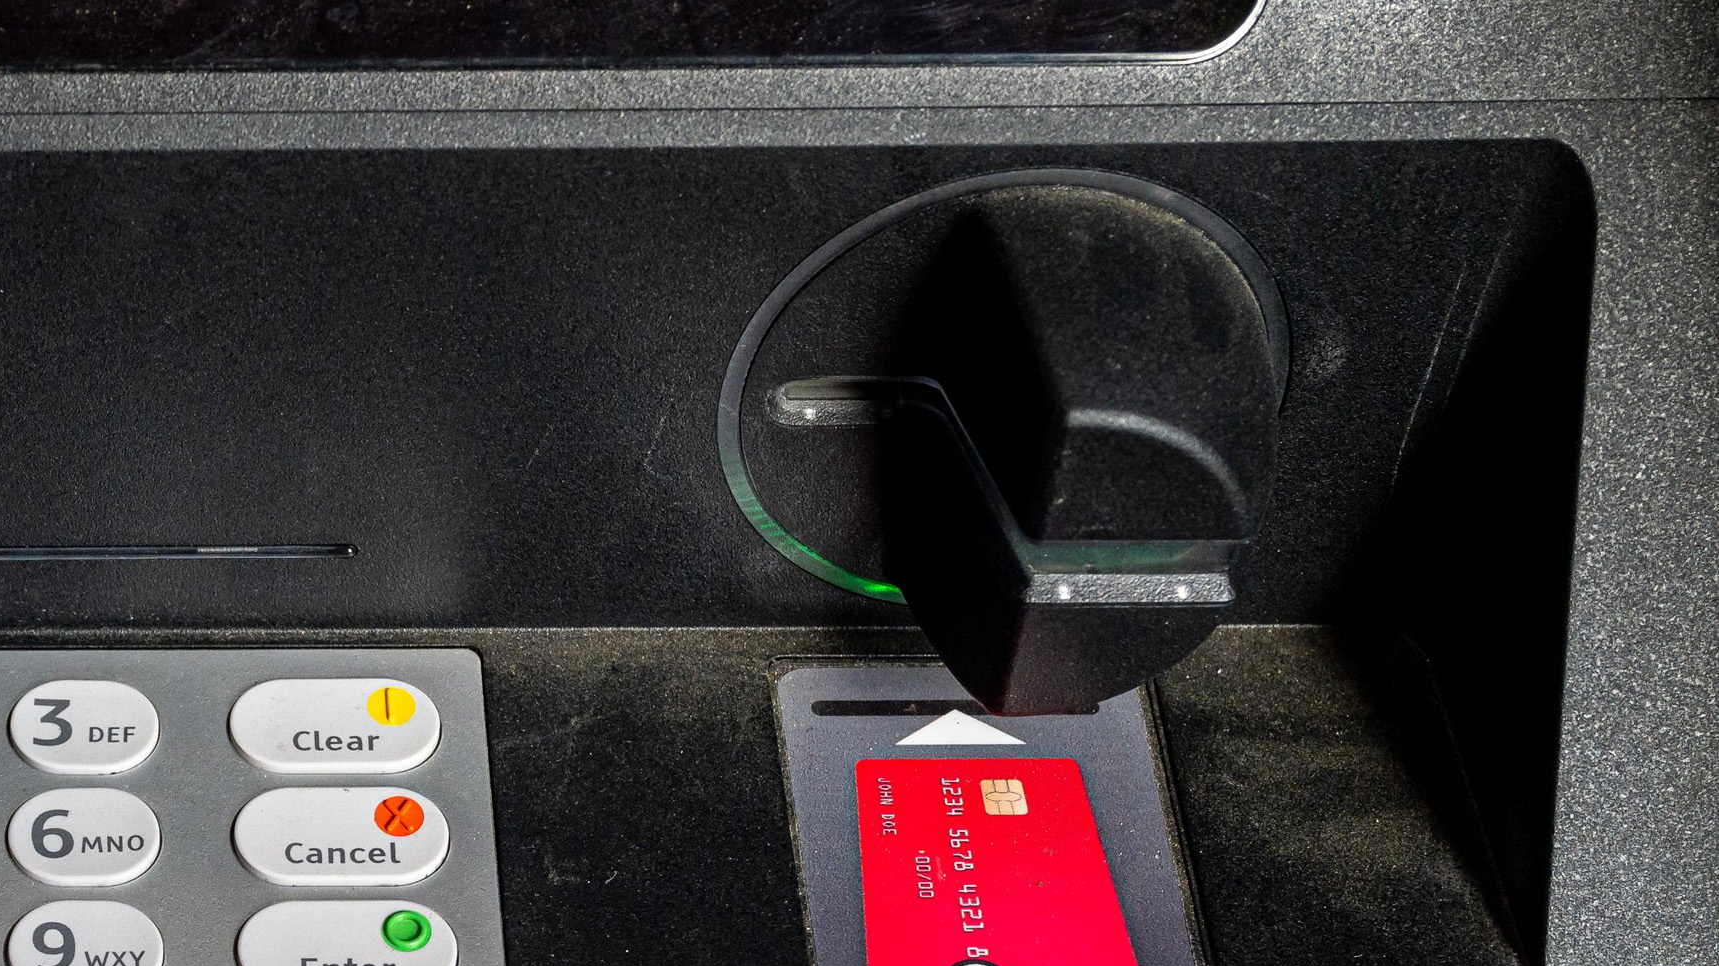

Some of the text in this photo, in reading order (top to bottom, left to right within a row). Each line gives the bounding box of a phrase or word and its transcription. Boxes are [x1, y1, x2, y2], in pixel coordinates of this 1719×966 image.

[33, 699, 135, 746] 3 DEF
[293, 731, 379, 751] Clear
[878, 778, 897, 835] JOHN DOE
[32, 810, 144, 858] 6 MNO
[285, 843, 400, 863] Cancel
[942, 778, 988, 957] 1234 5678 4321 8
